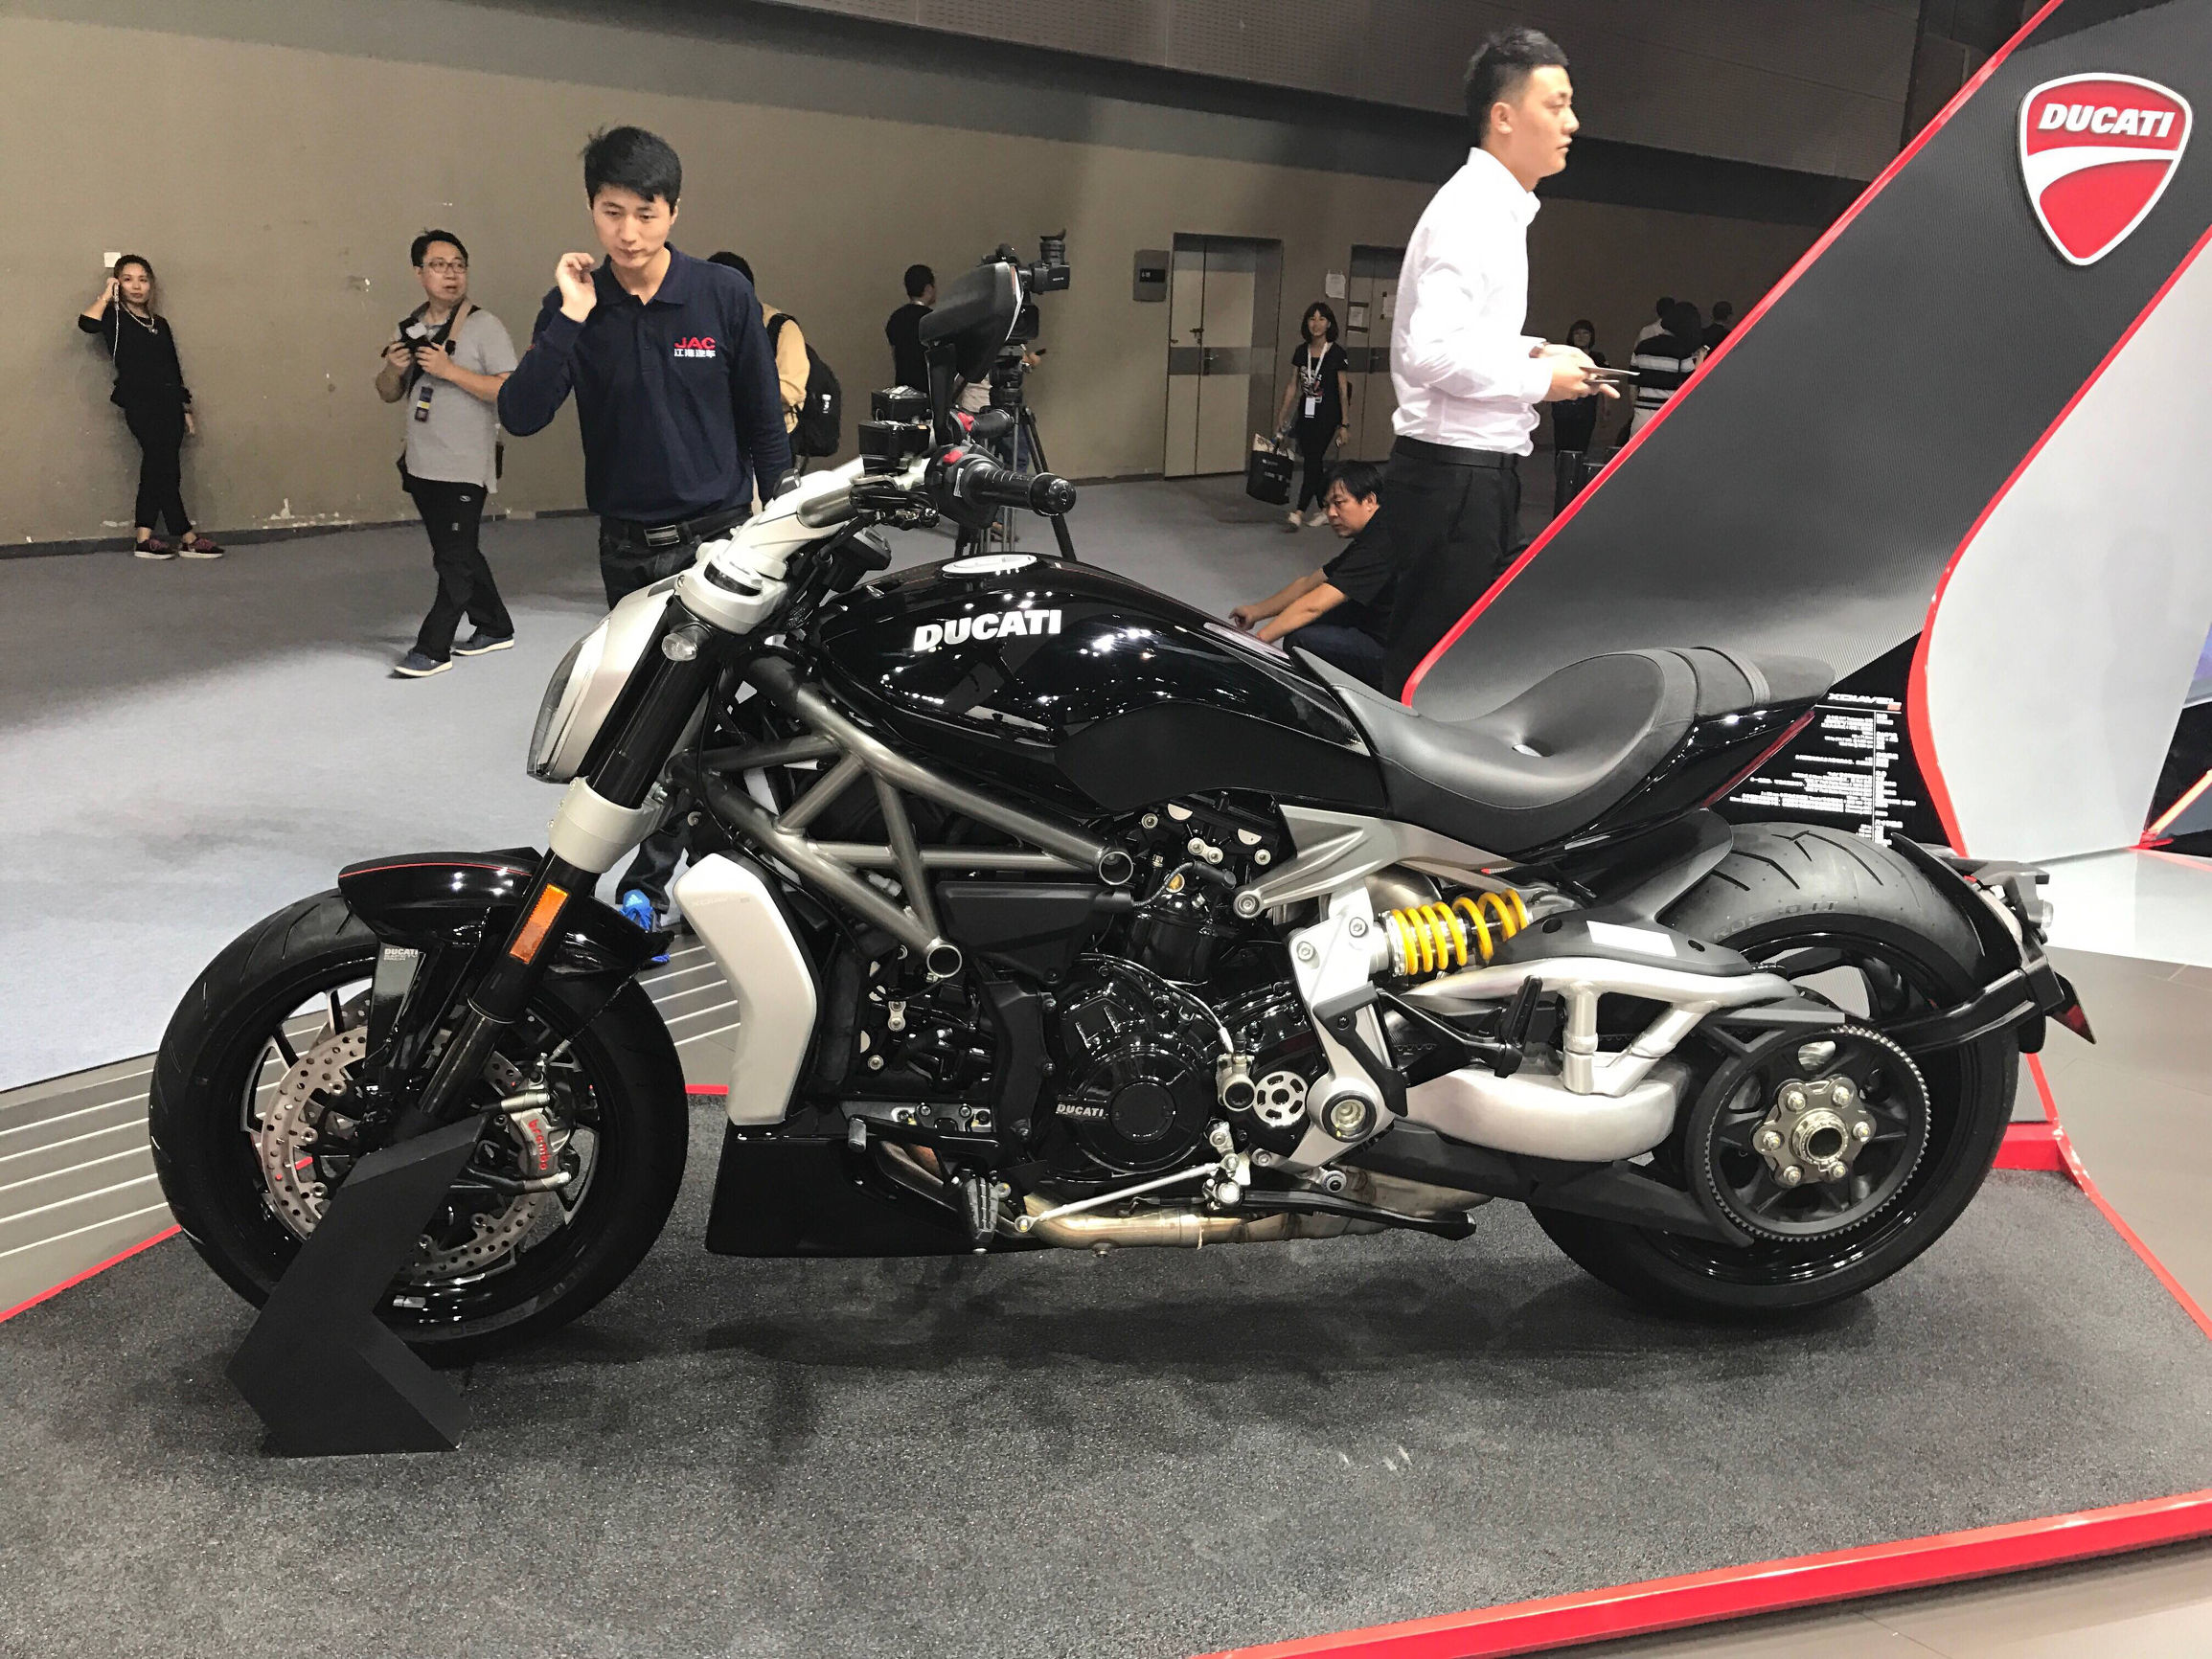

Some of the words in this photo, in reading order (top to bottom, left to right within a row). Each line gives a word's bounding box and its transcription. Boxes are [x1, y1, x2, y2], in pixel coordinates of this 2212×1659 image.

[2038, 102, 2176, 138] DUCATI
[674, 337, 716, 350] JAC
[913, 609, 1061, 652] DUCATI
[1056, 1103, 1105, 1117] DUCATI
[528, 1118, 551, 1170] brembo
